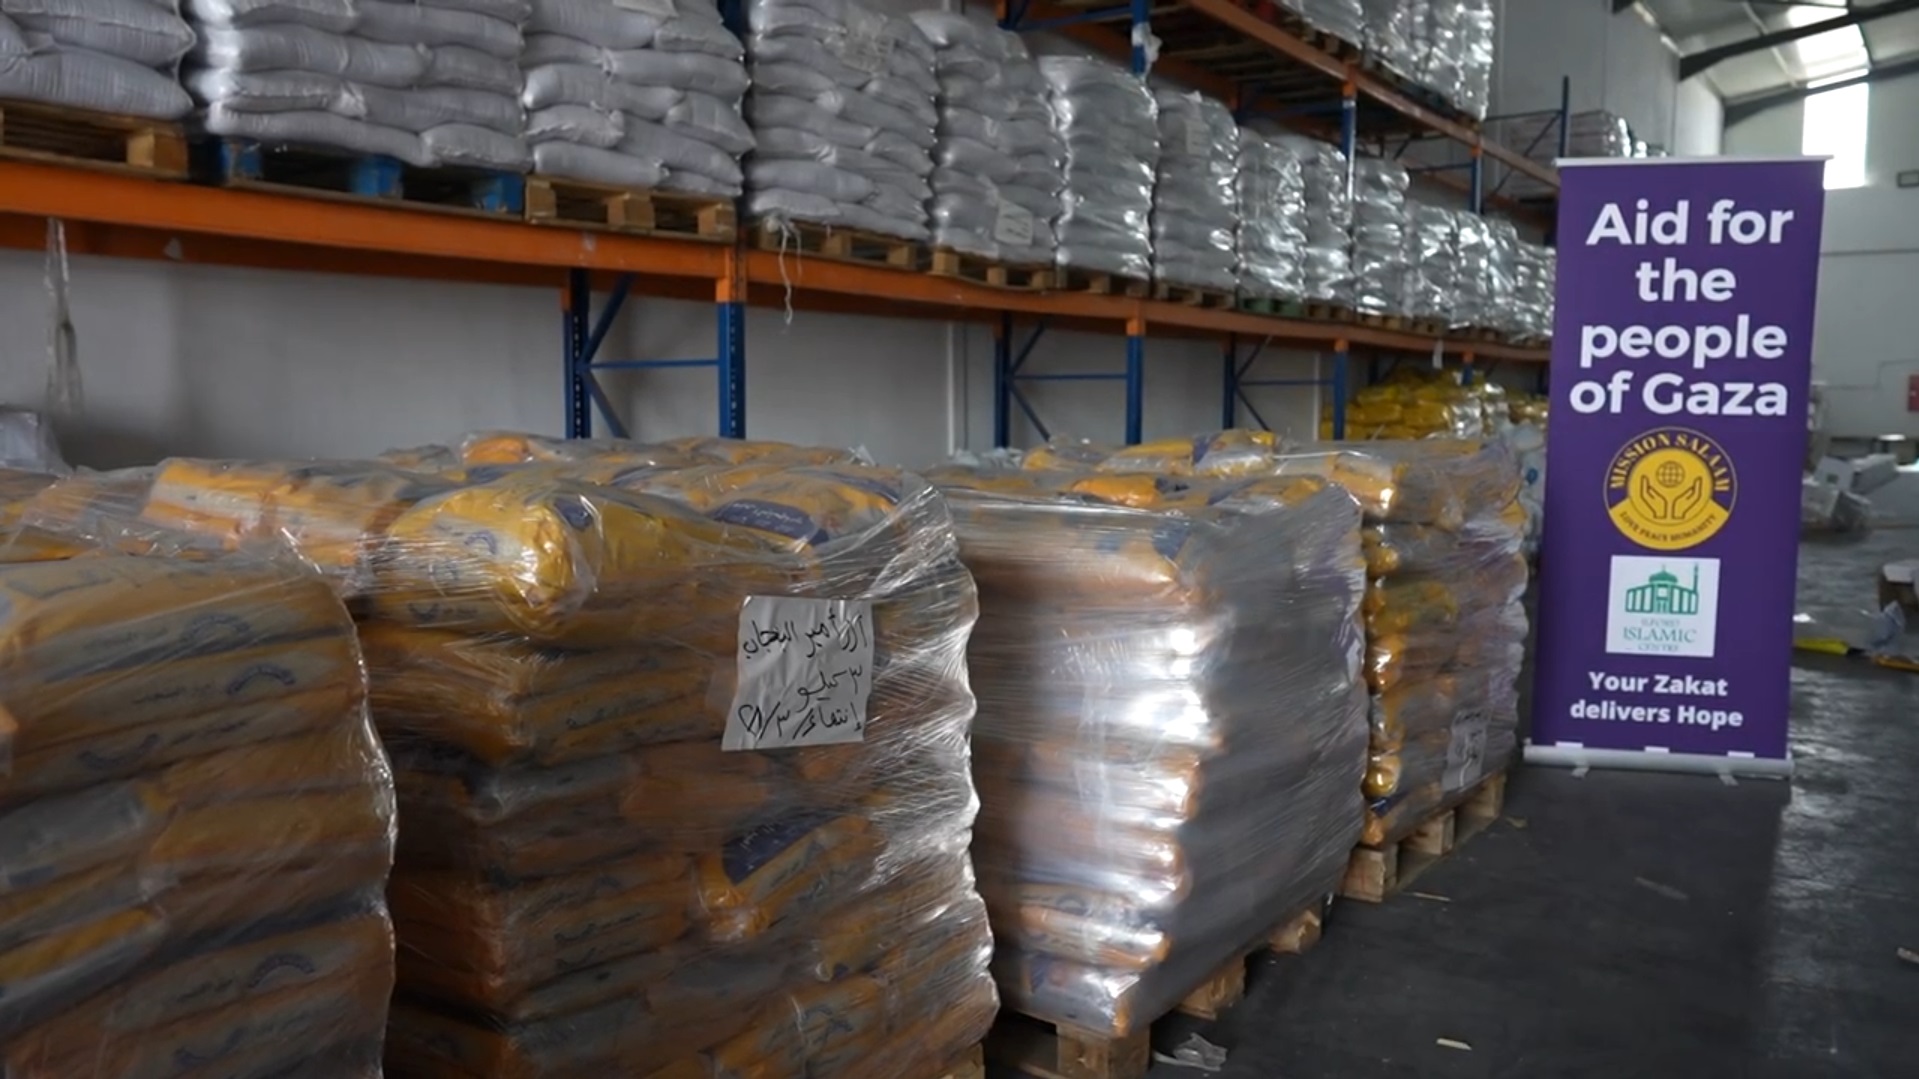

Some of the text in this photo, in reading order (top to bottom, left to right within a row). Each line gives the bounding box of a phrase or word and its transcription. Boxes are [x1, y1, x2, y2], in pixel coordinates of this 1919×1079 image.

[1586, 198, 1794, 245] Aid for
[1636, 258, 1736, 302] the
[1580, 314, 1787, 368] people
[1569, 370, 1788, 416] of Gaza
[1610, 432, 1731, 492] MISSION SALAAM
[1623, 626, 1697, 643] ISLAMIC
[1588, 671, 1728, 696] Your Zakat
[1570, 699, 1743, 730] delivers Hope
